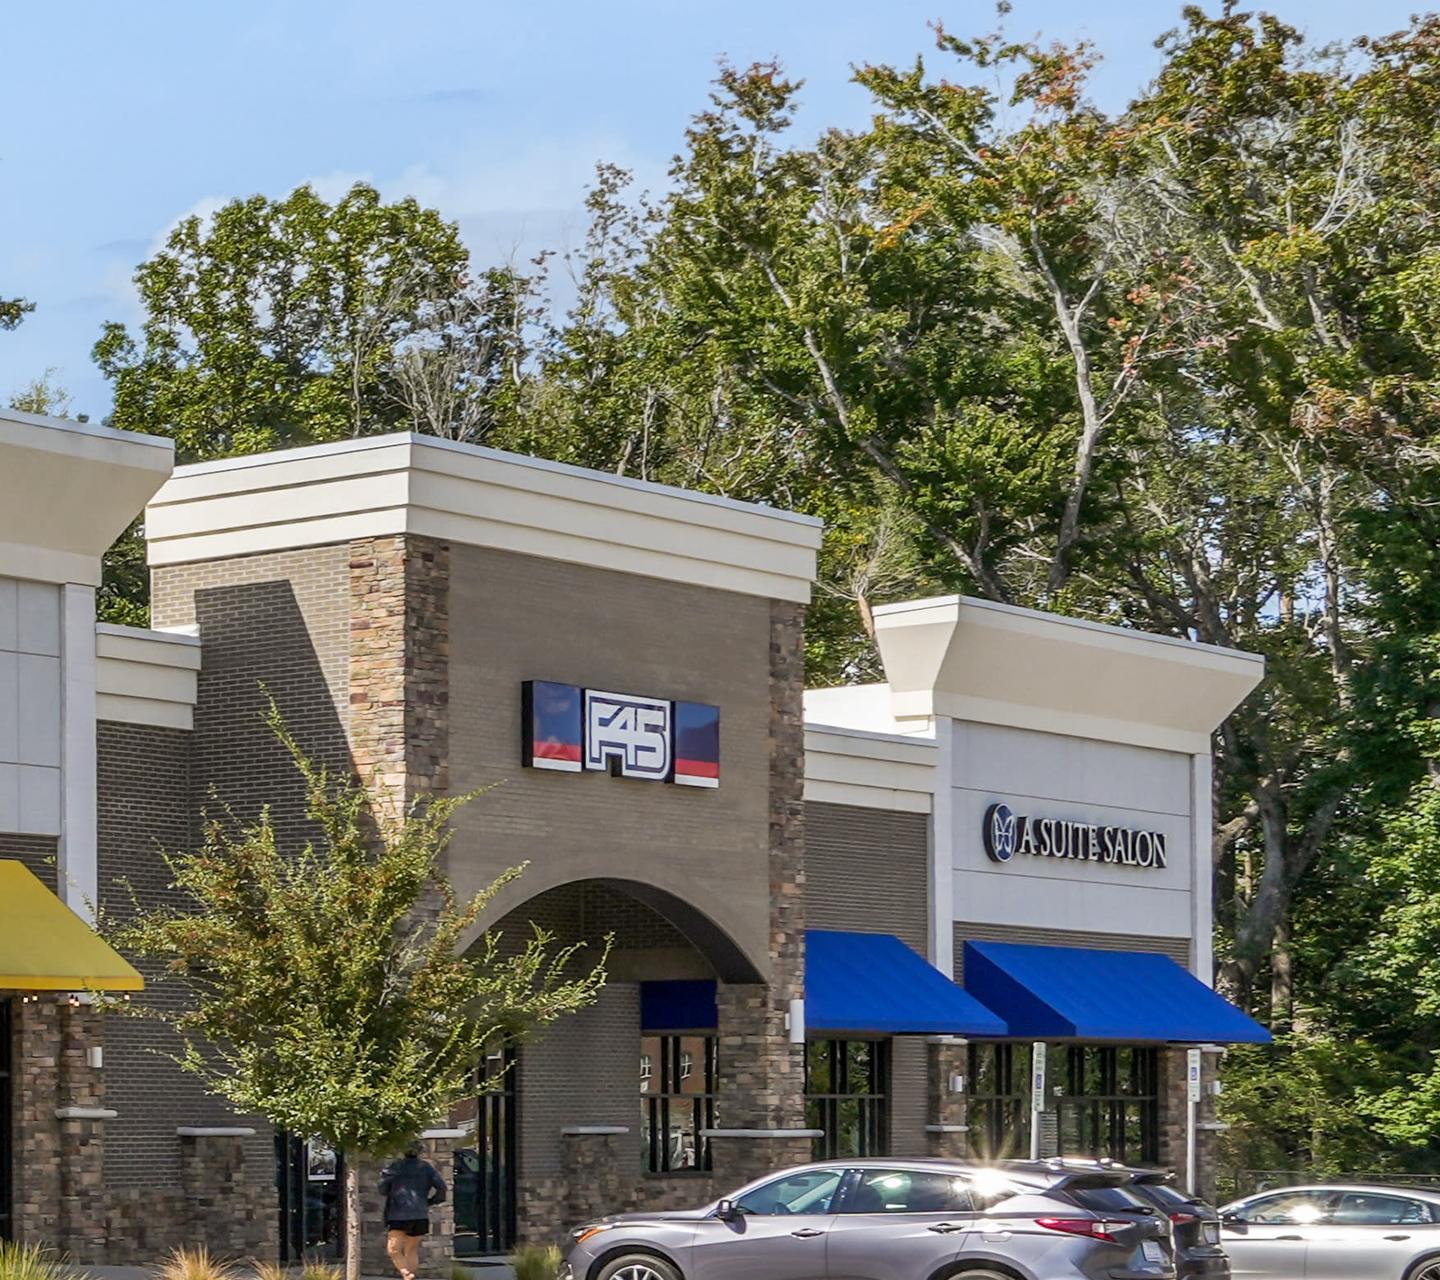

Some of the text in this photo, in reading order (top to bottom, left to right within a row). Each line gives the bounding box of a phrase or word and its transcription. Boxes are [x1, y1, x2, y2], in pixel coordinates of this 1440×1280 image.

[585, 688, 671, 780] F45
[1017, 817, 1168, 869] A SUITE SALON
